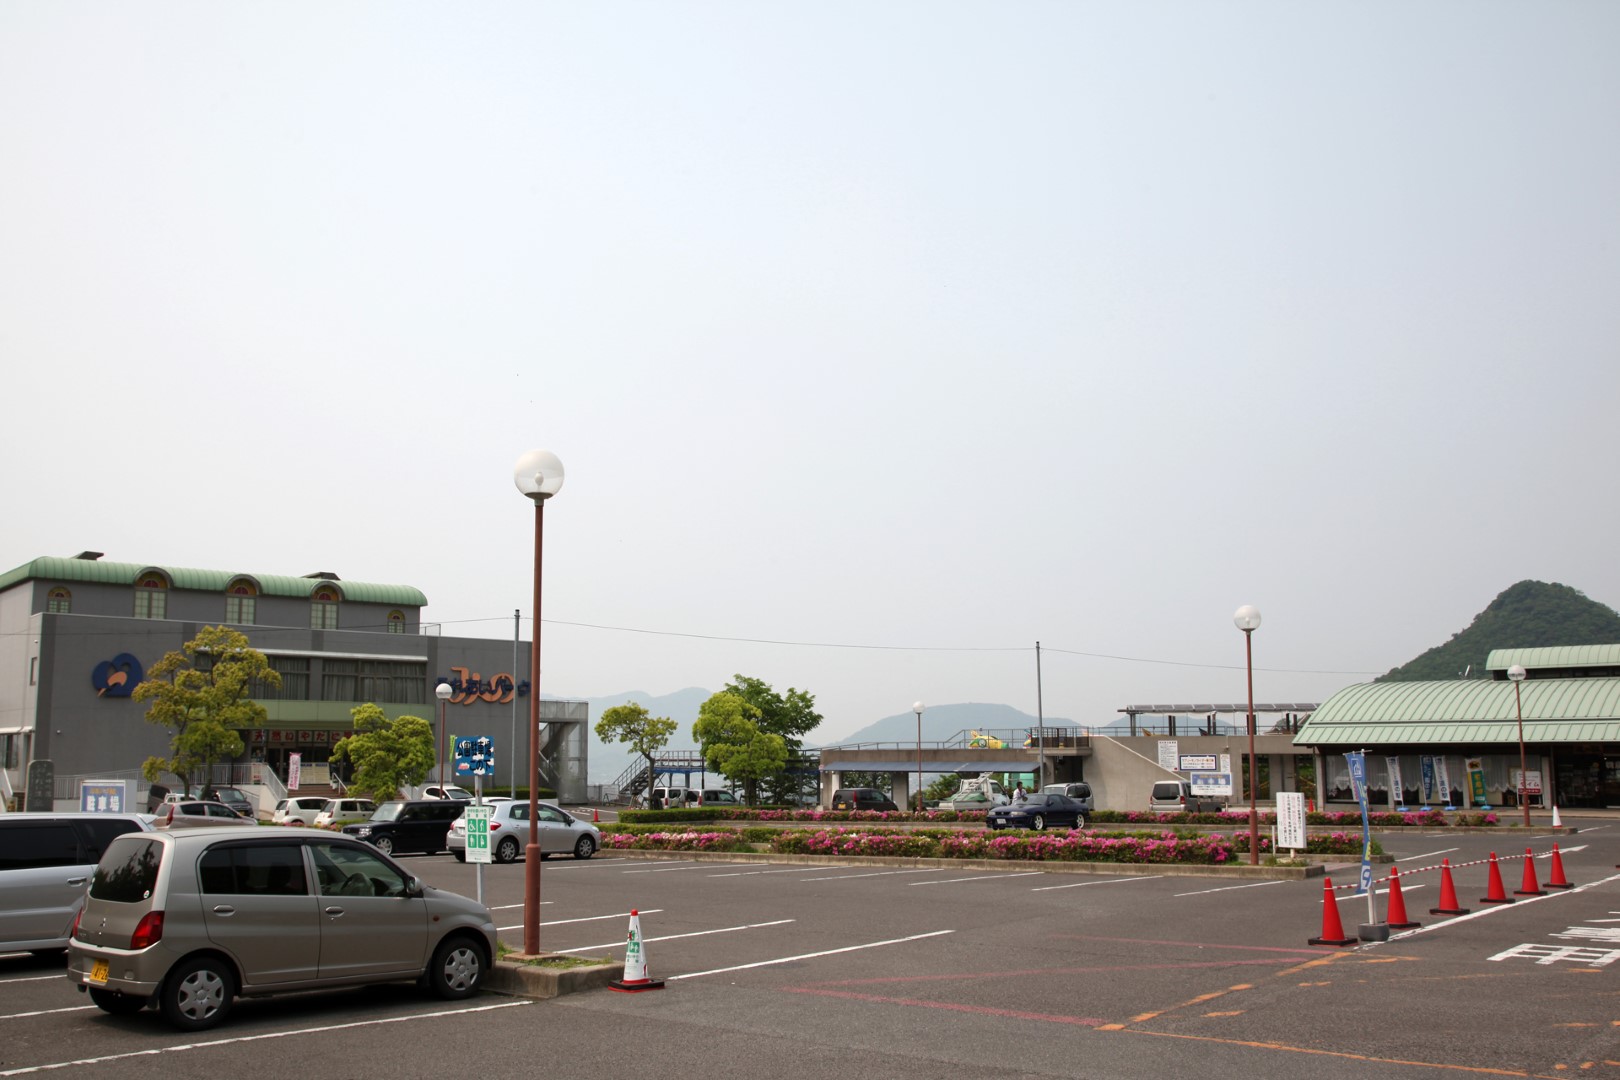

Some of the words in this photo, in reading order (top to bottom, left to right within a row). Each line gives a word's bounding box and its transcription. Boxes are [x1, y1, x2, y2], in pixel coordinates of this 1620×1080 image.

[457, 740, 492, 757] 公園駐車場
[470, 759, 491, 772] この下
[86, 794, 120, 812] 駐車場
